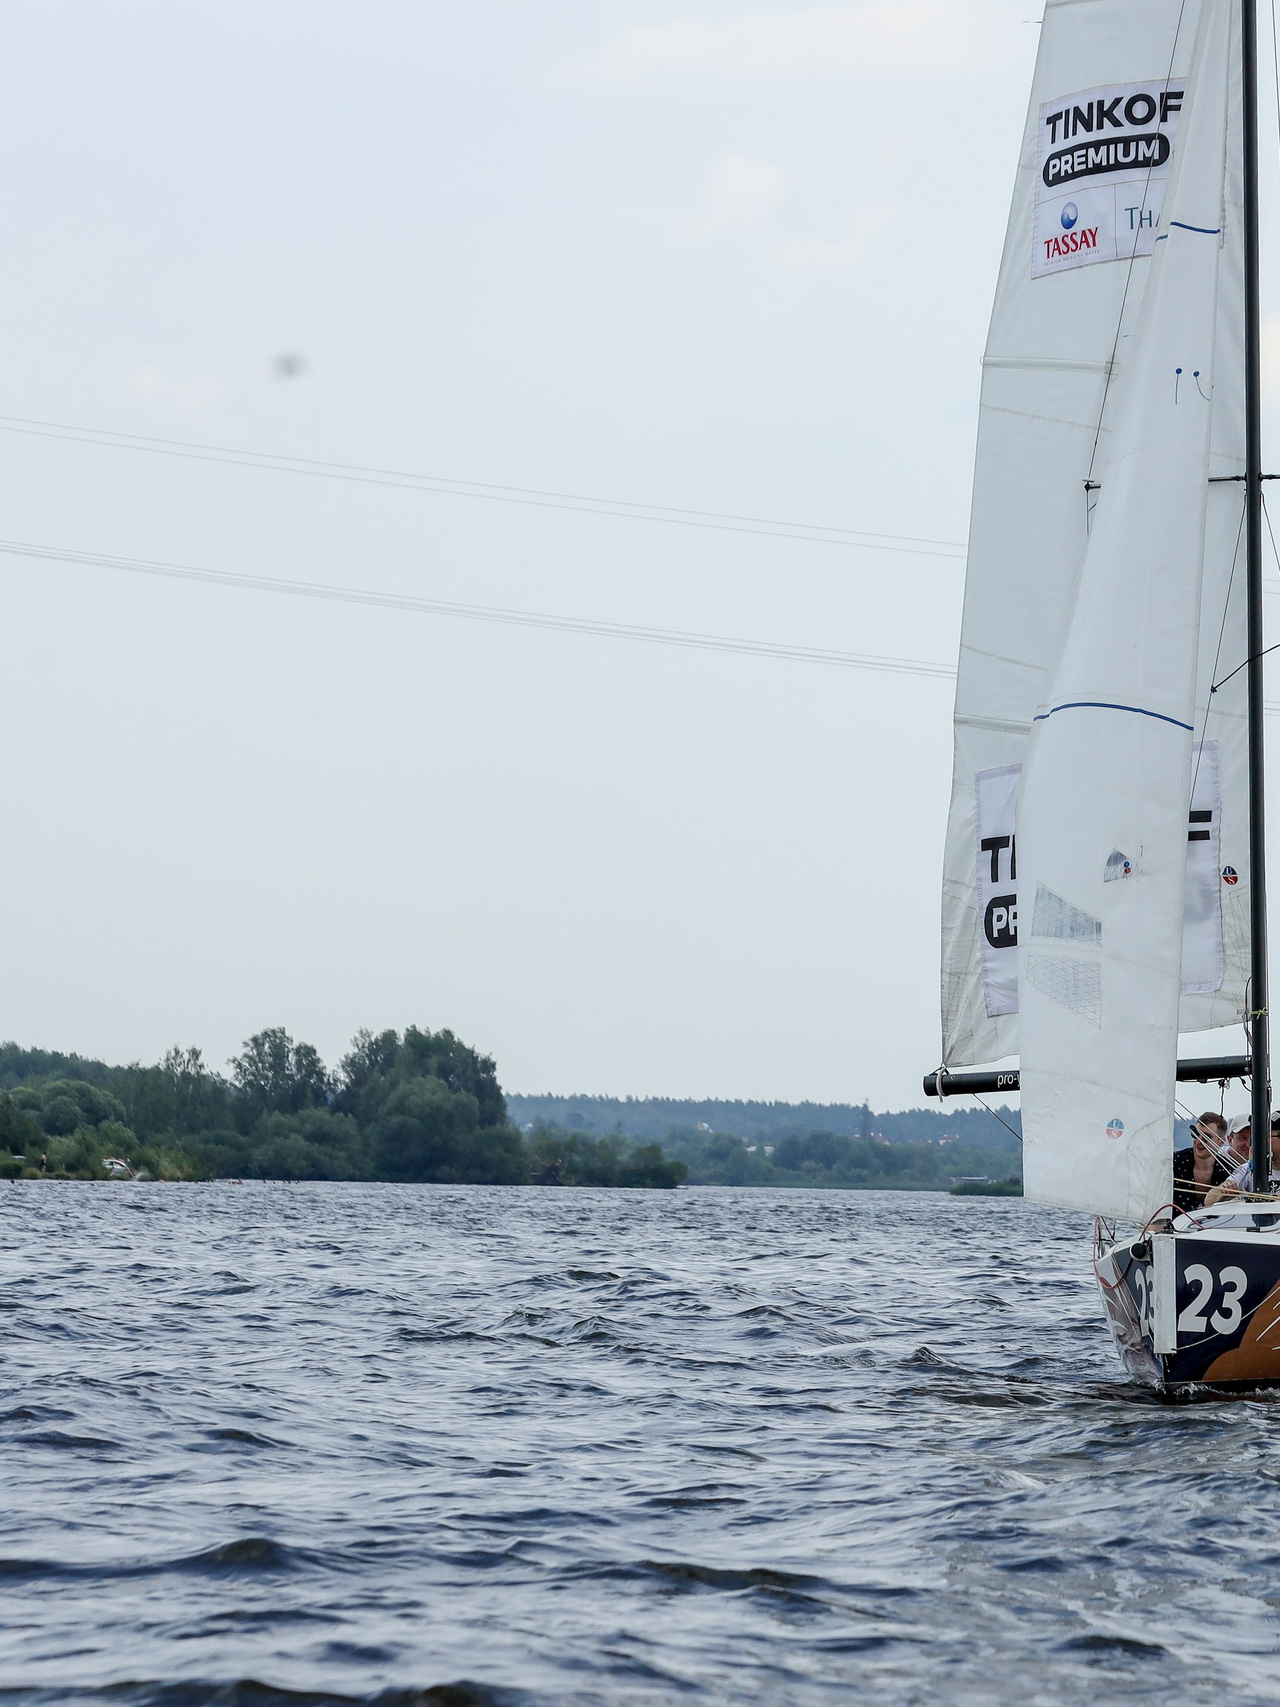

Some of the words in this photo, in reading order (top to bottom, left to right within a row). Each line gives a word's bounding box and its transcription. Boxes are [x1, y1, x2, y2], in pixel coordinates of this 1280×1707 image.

[1048, 139, 1160, 181] PREMIUM
[1044, 227, 1099, 259] TASSAY
[1177, 1263, 1248, 1335] 23
